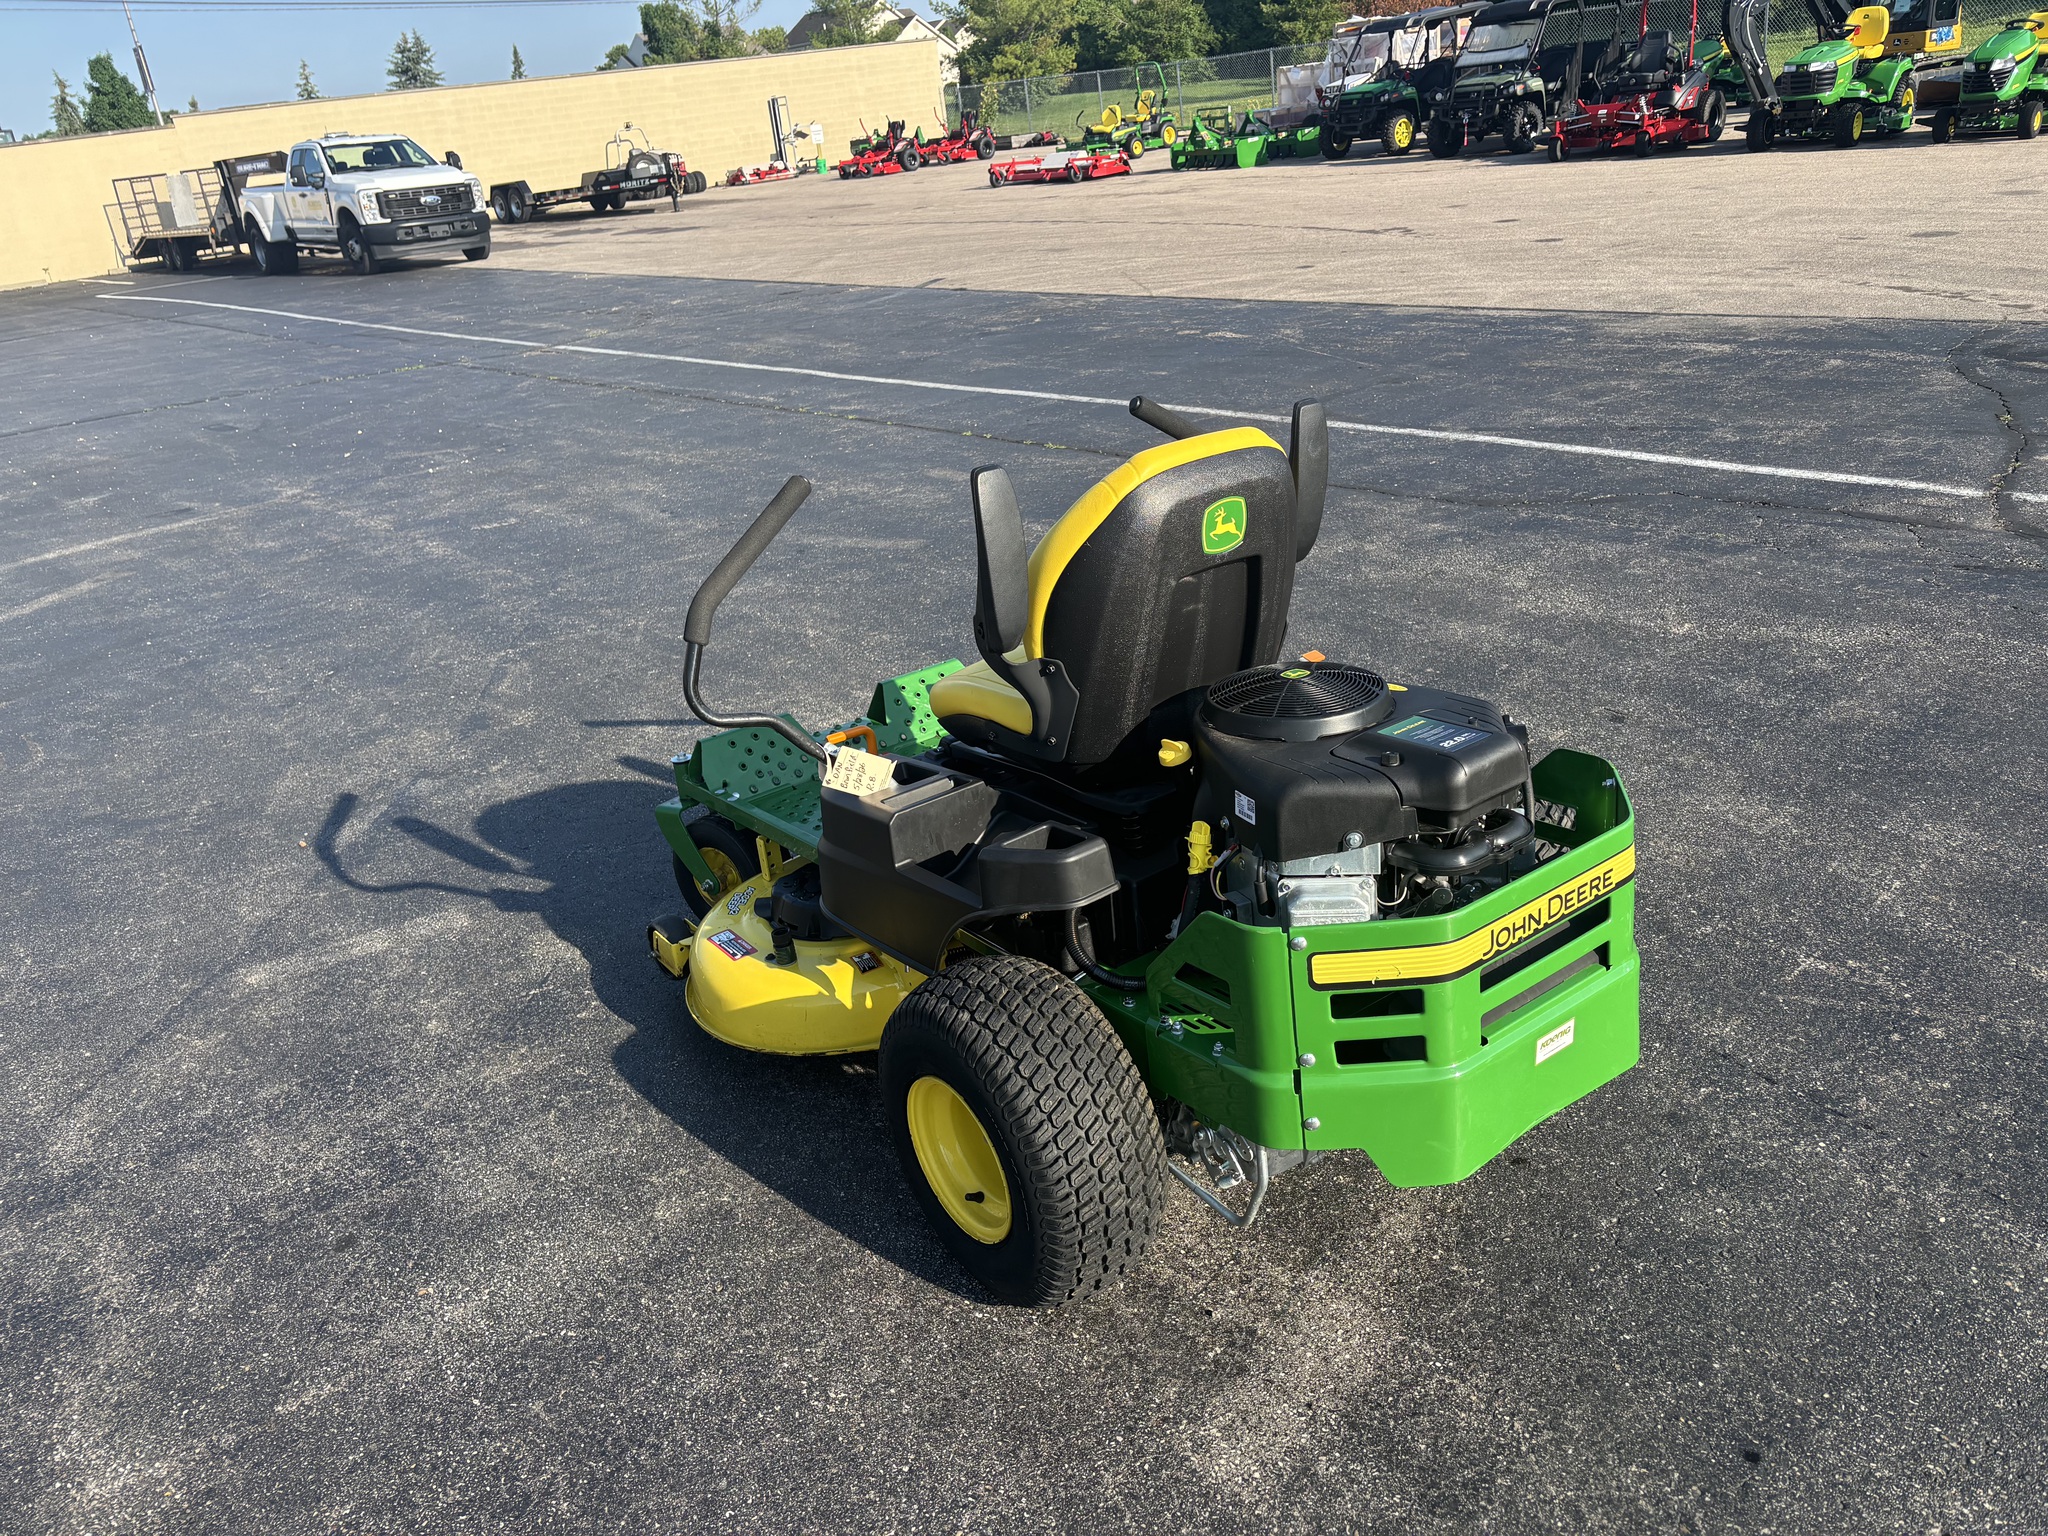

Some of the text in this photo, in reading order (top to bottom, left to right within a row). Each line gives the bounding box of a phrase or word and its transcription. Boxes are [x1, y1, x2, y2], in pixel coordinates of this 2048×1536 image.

[620, 178, 650, 189] MORITZ
[1482, 868, 1614, 958] JOHN DEERE
